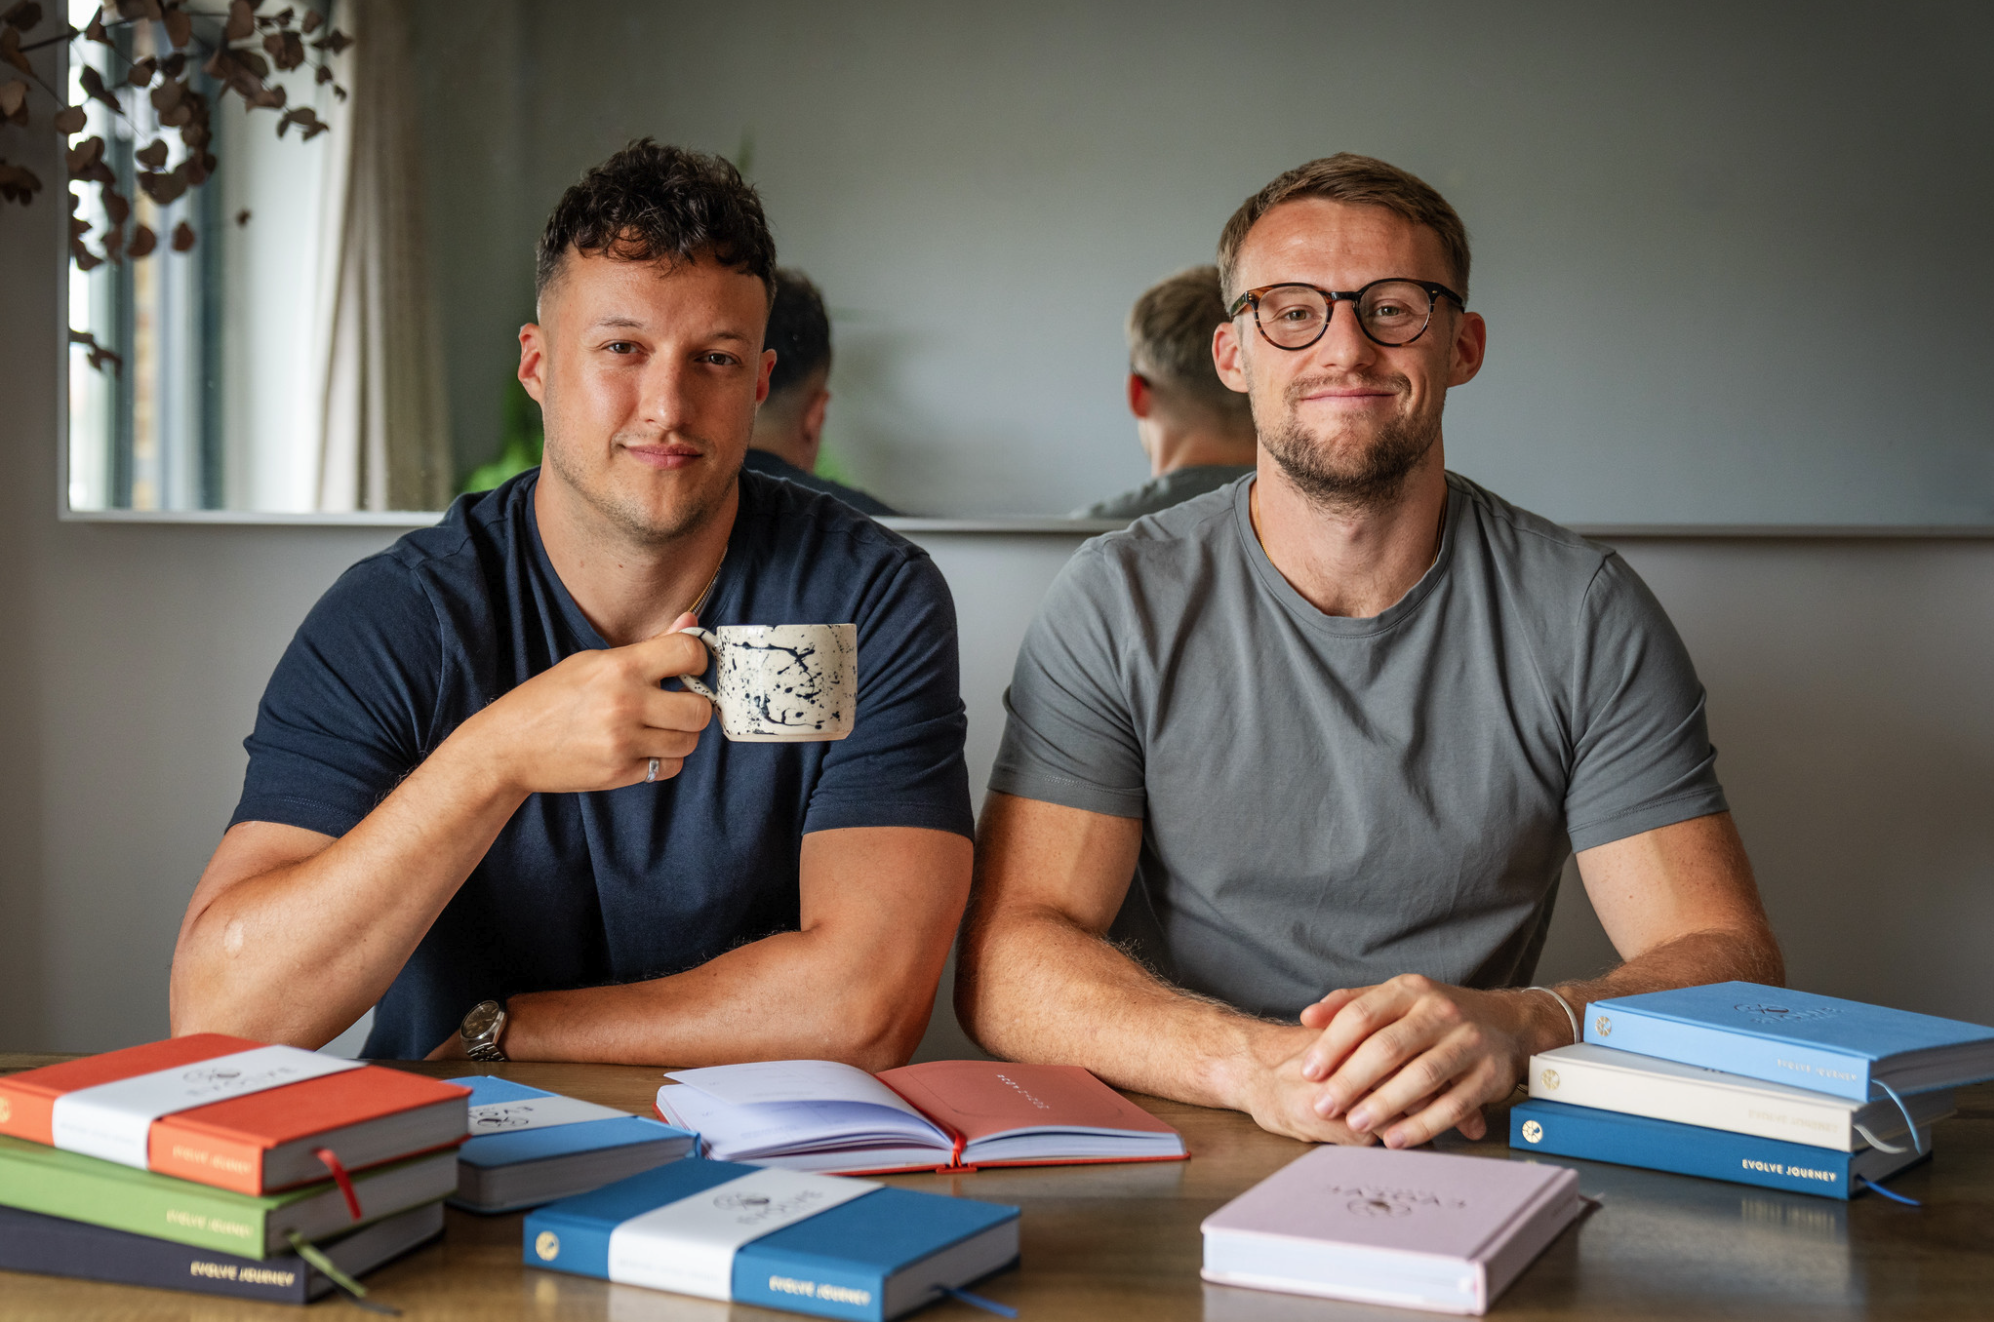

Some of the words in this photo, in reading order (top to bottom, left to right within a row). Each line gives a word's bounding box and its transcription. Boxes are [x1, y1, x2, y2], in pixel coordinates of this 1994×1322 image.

[1742, 1159, 1783, 1175] EVOLVE
[1786, 1165, 1836, 1182] JOURNEY
[190, 1261, 237, 1281] EVOLVE
[239, 1267, 295, 1287] JOURNEY
[769, 1275, 814, 1298] EVOLVE
[816, 1284, 871, 1307] JOURNEY
